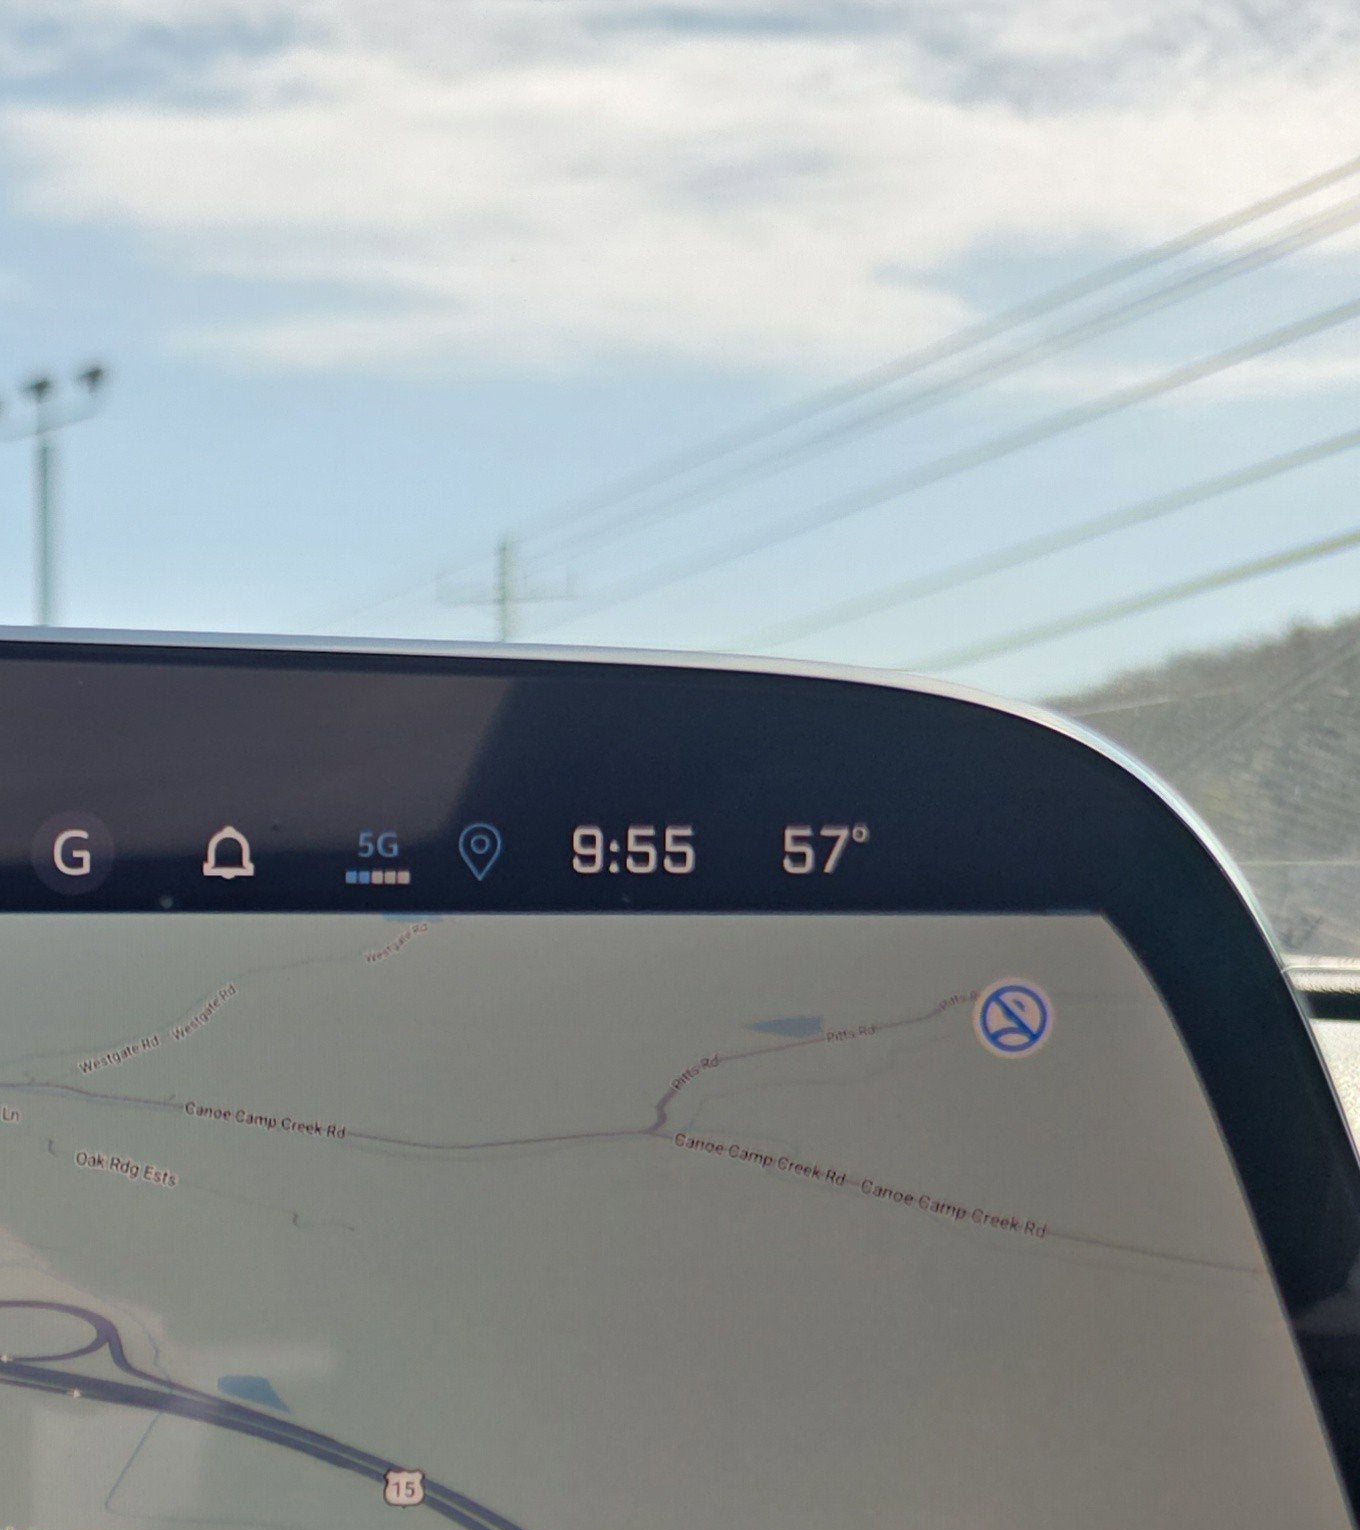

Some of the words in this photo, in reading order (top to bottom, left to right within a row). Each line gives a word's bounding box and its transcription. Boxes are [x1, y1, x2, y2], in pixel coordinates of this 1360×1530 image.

[52, 830, 92, 876] G
[357, 832, 400, 858] 5G
[571, 825, 697, 876] 9:55
[782, 822, 871, 876] 57°
[411, 922, 429, 935] Rd
[171, 997, 221, 1042] Westgate
[218, 983, 237, 1001] Rd
[826, 1031, 856, 1044] Pitts
[858, 1025, 876, 1037] Rd
[78, 1045, 138, 1074] Westgate
[140, 1034, 160, 1051] Rd
[671, 1064, 700, 1091] Pitts
[699, 1054, 720, 1070] Rd
[2, 1107, 21, 1122] Ln
[184, 1101, 232, 1121] Canoe
[235, 1110, 277, 1131] Camp
[281, 1117, 323, 1136] Creek
[326, 1123, 347, 1139] Rd
[76, 1151, 105, 1169] Oak
[109, 1157, 140, 1179] Rdg
[143, 1165, 178, 1187] Ests
[674, 1132, 724, 1156] Canoe
[729, 1144, 773, 1168] Camp
[777, 1156, 822, 1180] Creek
[825, 1168, 847, 1187] Rd
[860, 1179, 915, 1206] Canoe
[918, 1194, 966, 1220] Camp
[971, 1208, 1019, 1233] Creek
[1023, 1220, 1048, 1240] Rd
[392, 1478, 416, 1499] 15
